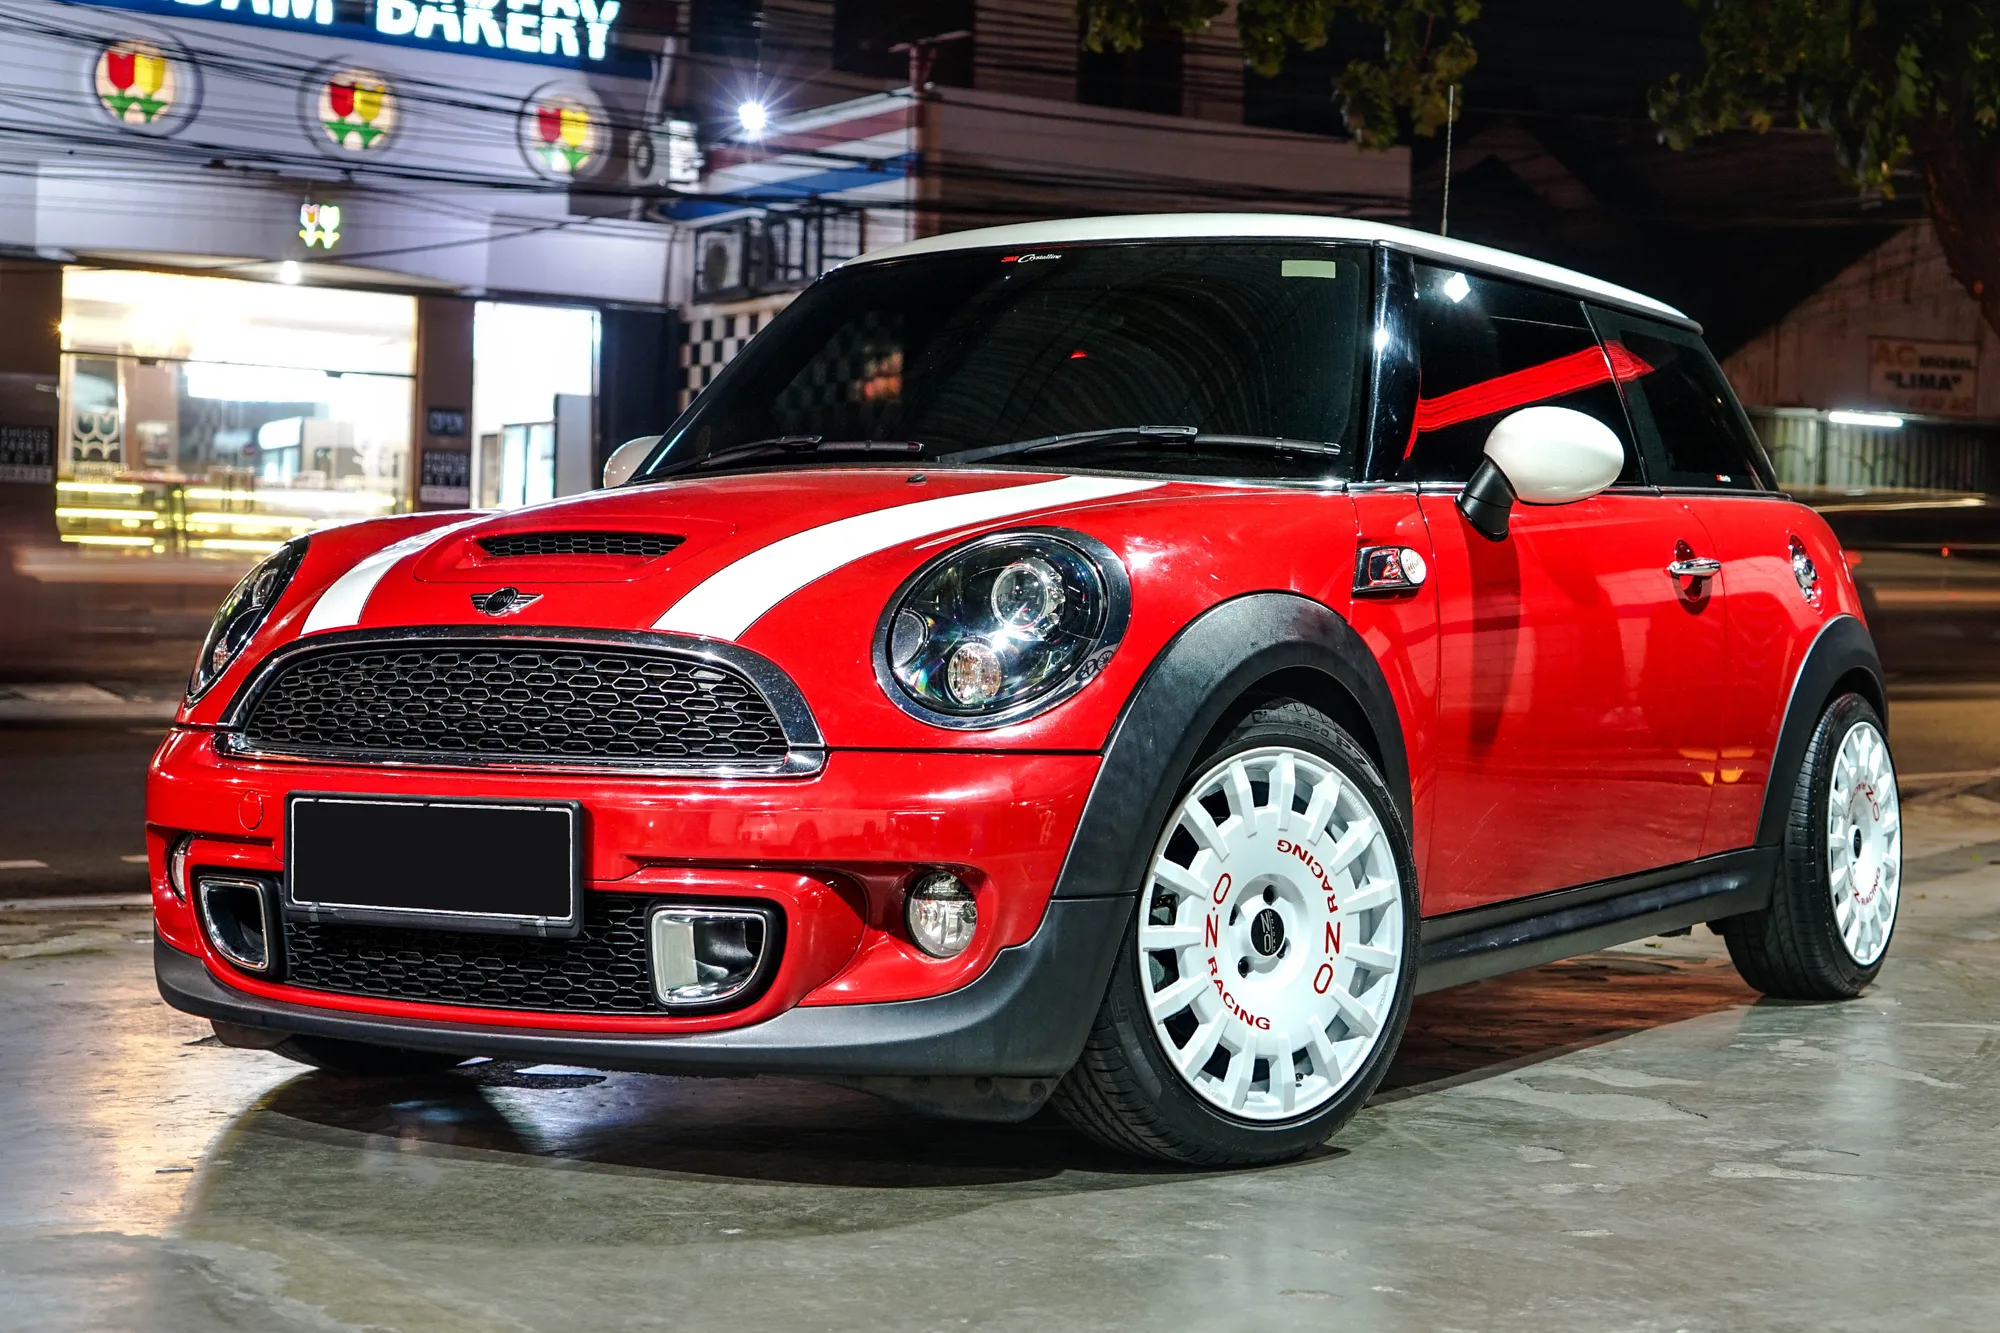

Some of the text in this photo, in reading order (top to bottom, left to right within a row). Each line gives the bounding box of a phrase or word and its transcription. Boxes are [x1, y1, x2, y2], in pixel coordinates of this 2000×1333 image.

[376, 0, 621, 60] BAKERY
[1276, 839, 1339, 914] RACING
[1207, 956, 1271, 1030] RACING
